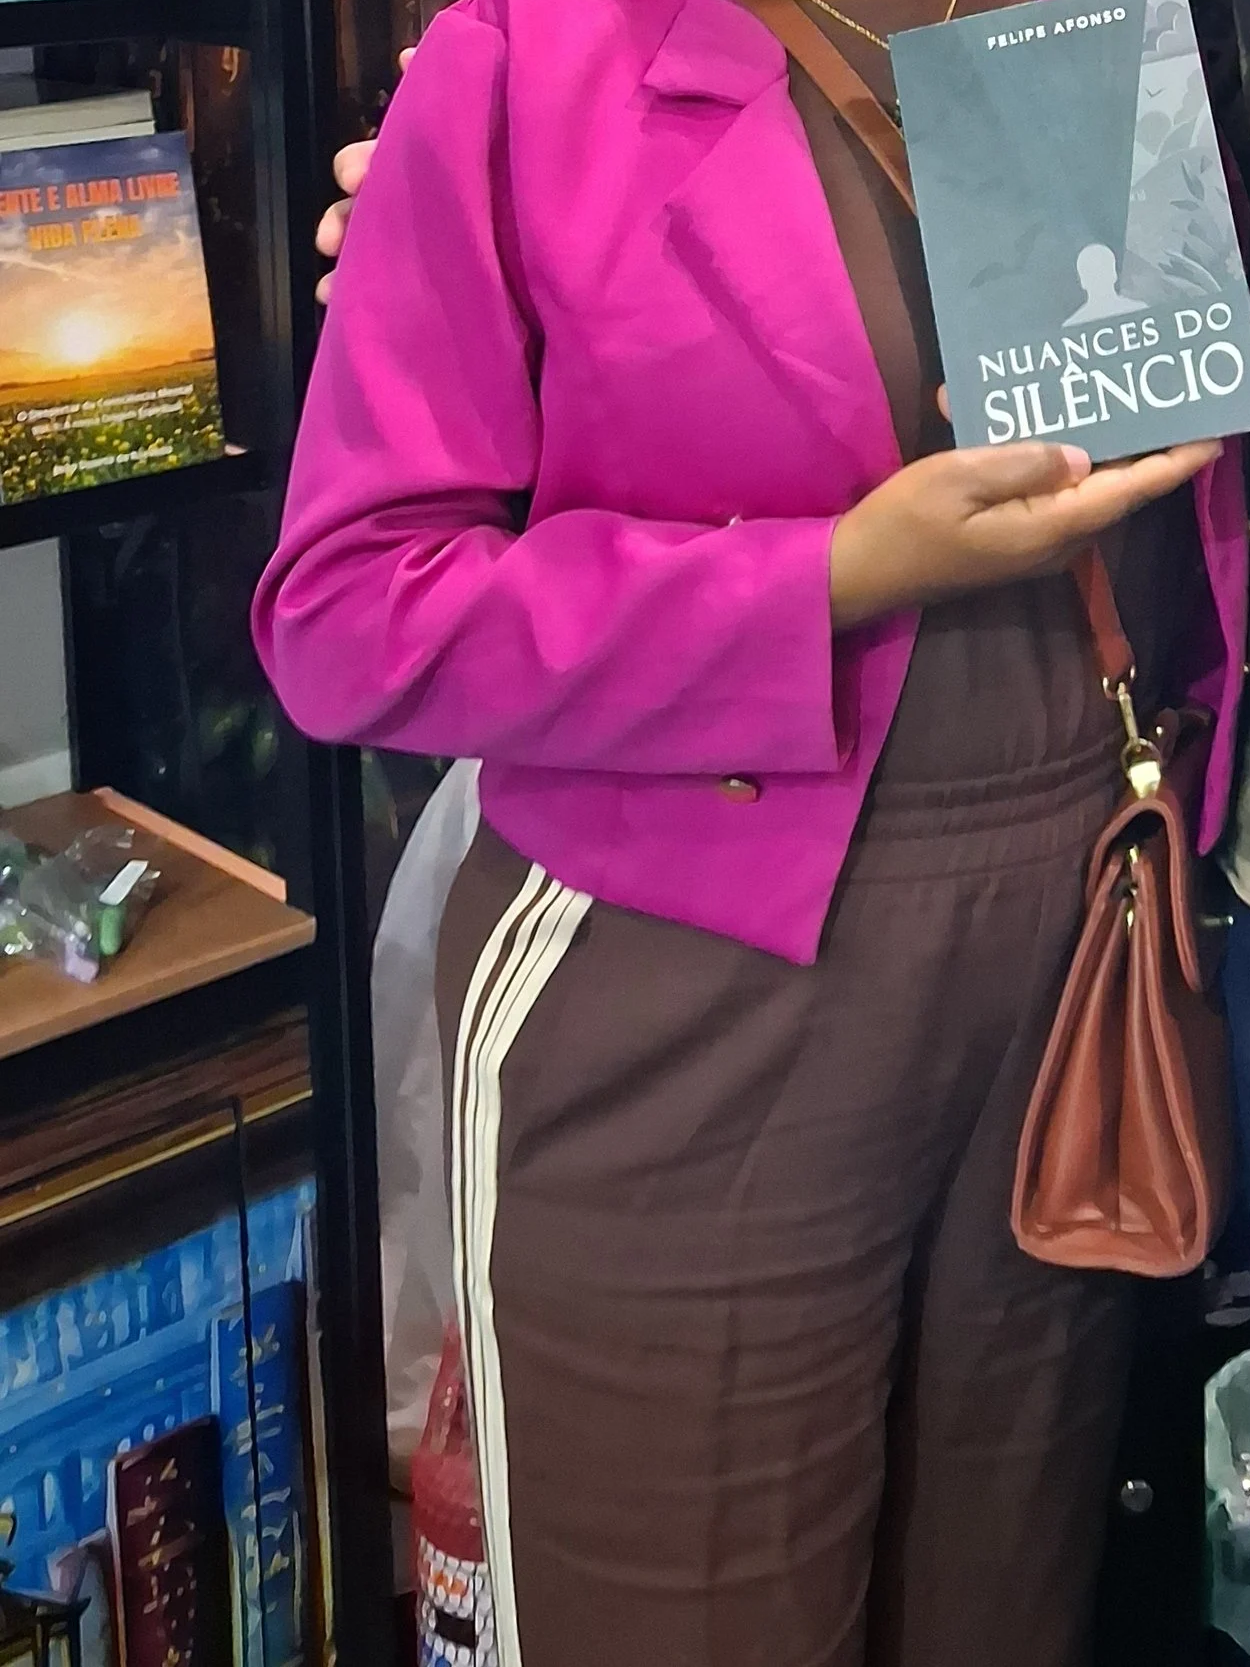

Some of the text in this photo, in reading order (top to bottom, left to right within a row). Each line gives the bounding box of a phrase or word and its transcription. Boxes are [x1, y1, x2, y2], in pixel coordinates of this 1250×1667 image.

[987, 7, 1127, 51] FELIPE AFONSO
[977, 302, 1233, 382] NUANCES DO
[984, 341, 1244, 446] SILÊNCIO
